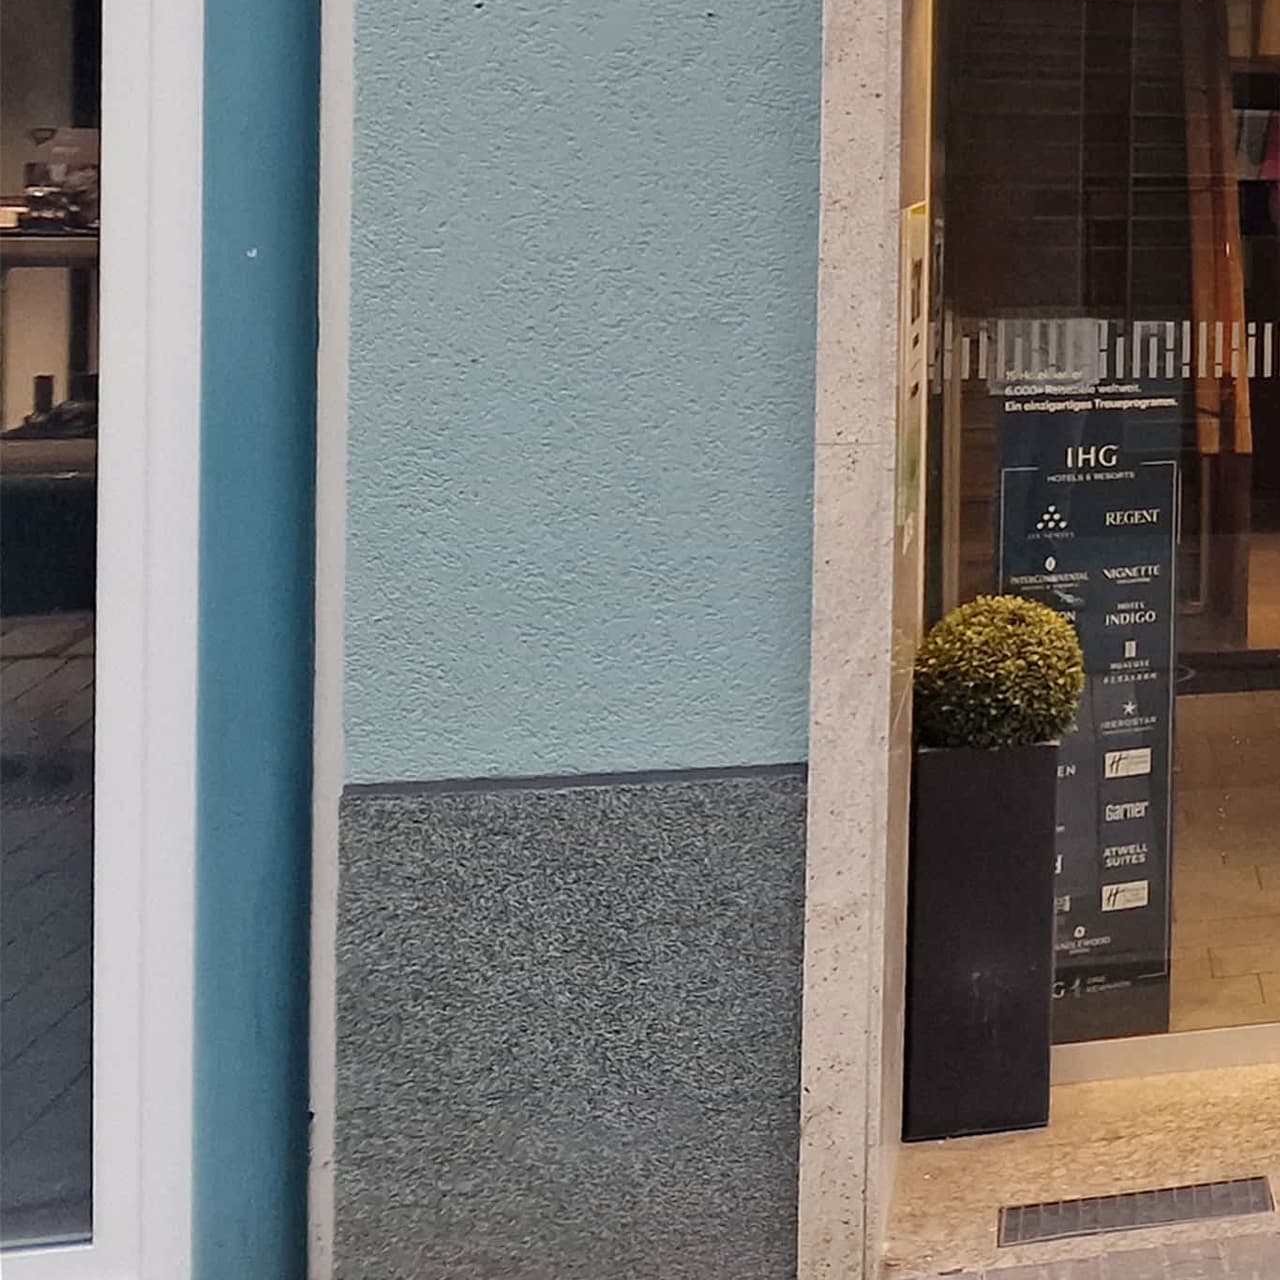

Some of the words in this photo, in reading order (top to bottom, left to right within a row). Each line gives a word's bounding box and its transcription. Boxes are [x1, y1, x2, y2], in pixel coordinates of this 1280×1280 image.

[1005, 401, 1022, 412] Ein
[1066, 445, 1119, 468] IHG
[1105, 508, 1160, 526] REGENT
[1103, 564, 1161, 579] VIGNETTE
[1105, 610, 1156, 626] INDIGO
[1106, 801, 1149, 821] Garner
[1103, 843, 1148, 857] ATWELL
[1105, 854, 1147, 868] SUITES
